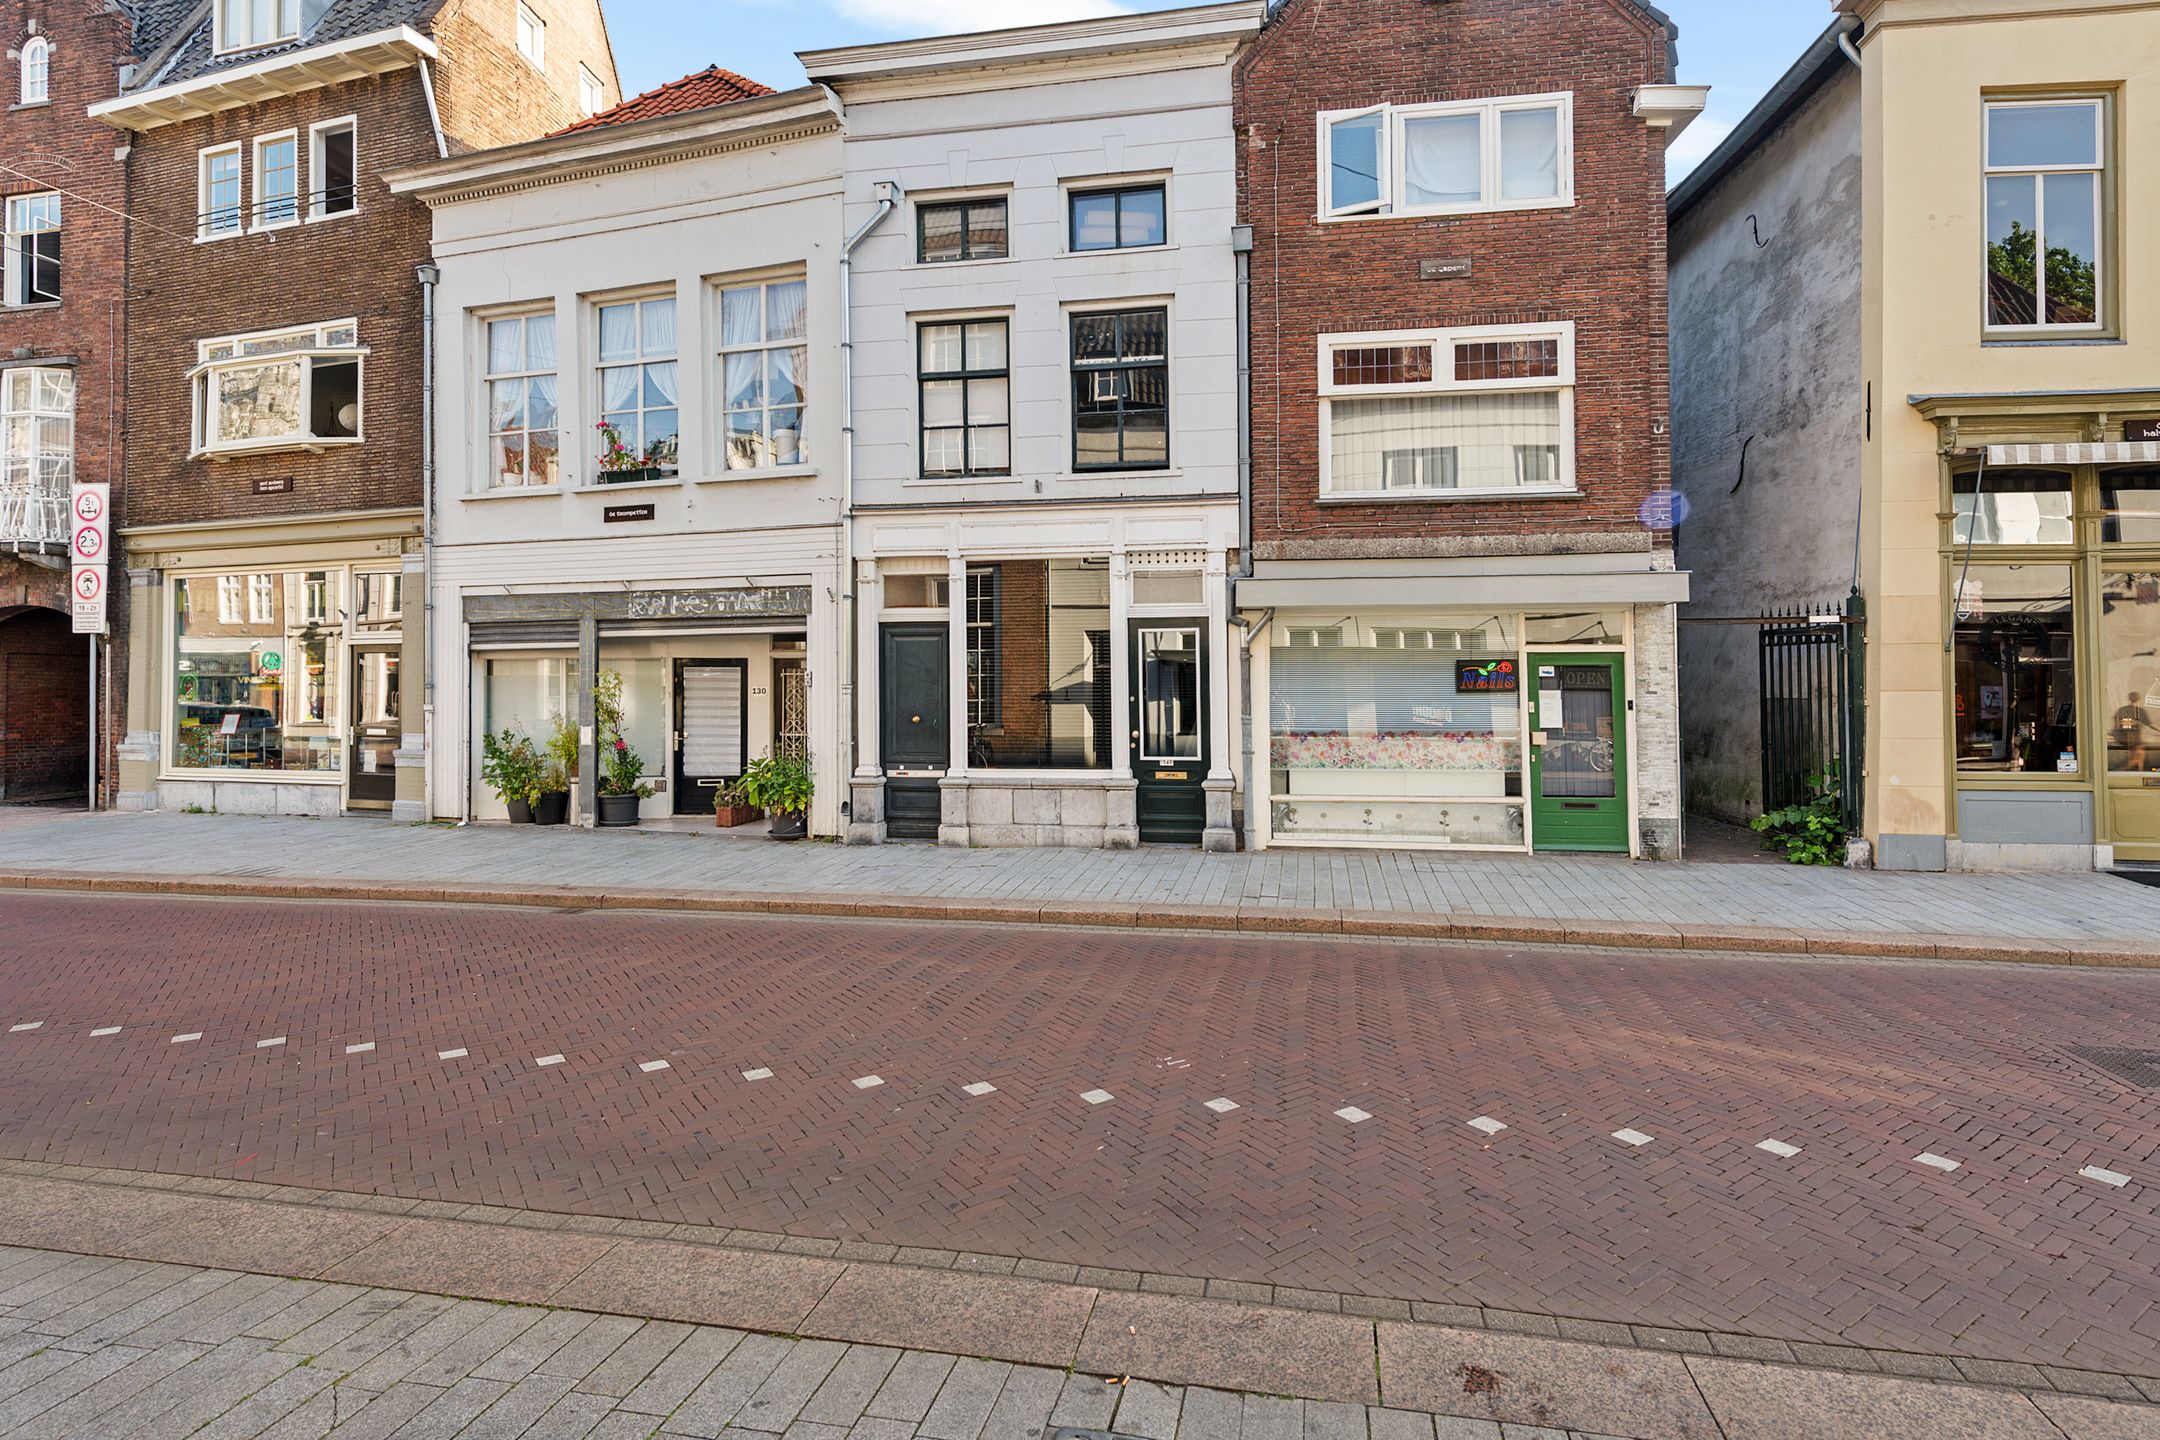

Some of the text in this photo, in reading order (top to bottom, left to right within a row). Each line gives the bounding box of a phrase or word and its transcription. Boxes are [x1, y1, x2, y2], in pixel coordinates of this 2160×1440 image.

[1460, 671, 1515, 689] Nails
[1566, 671, 1606, 685] OPEN
[752, 687, 767, 695] 130
